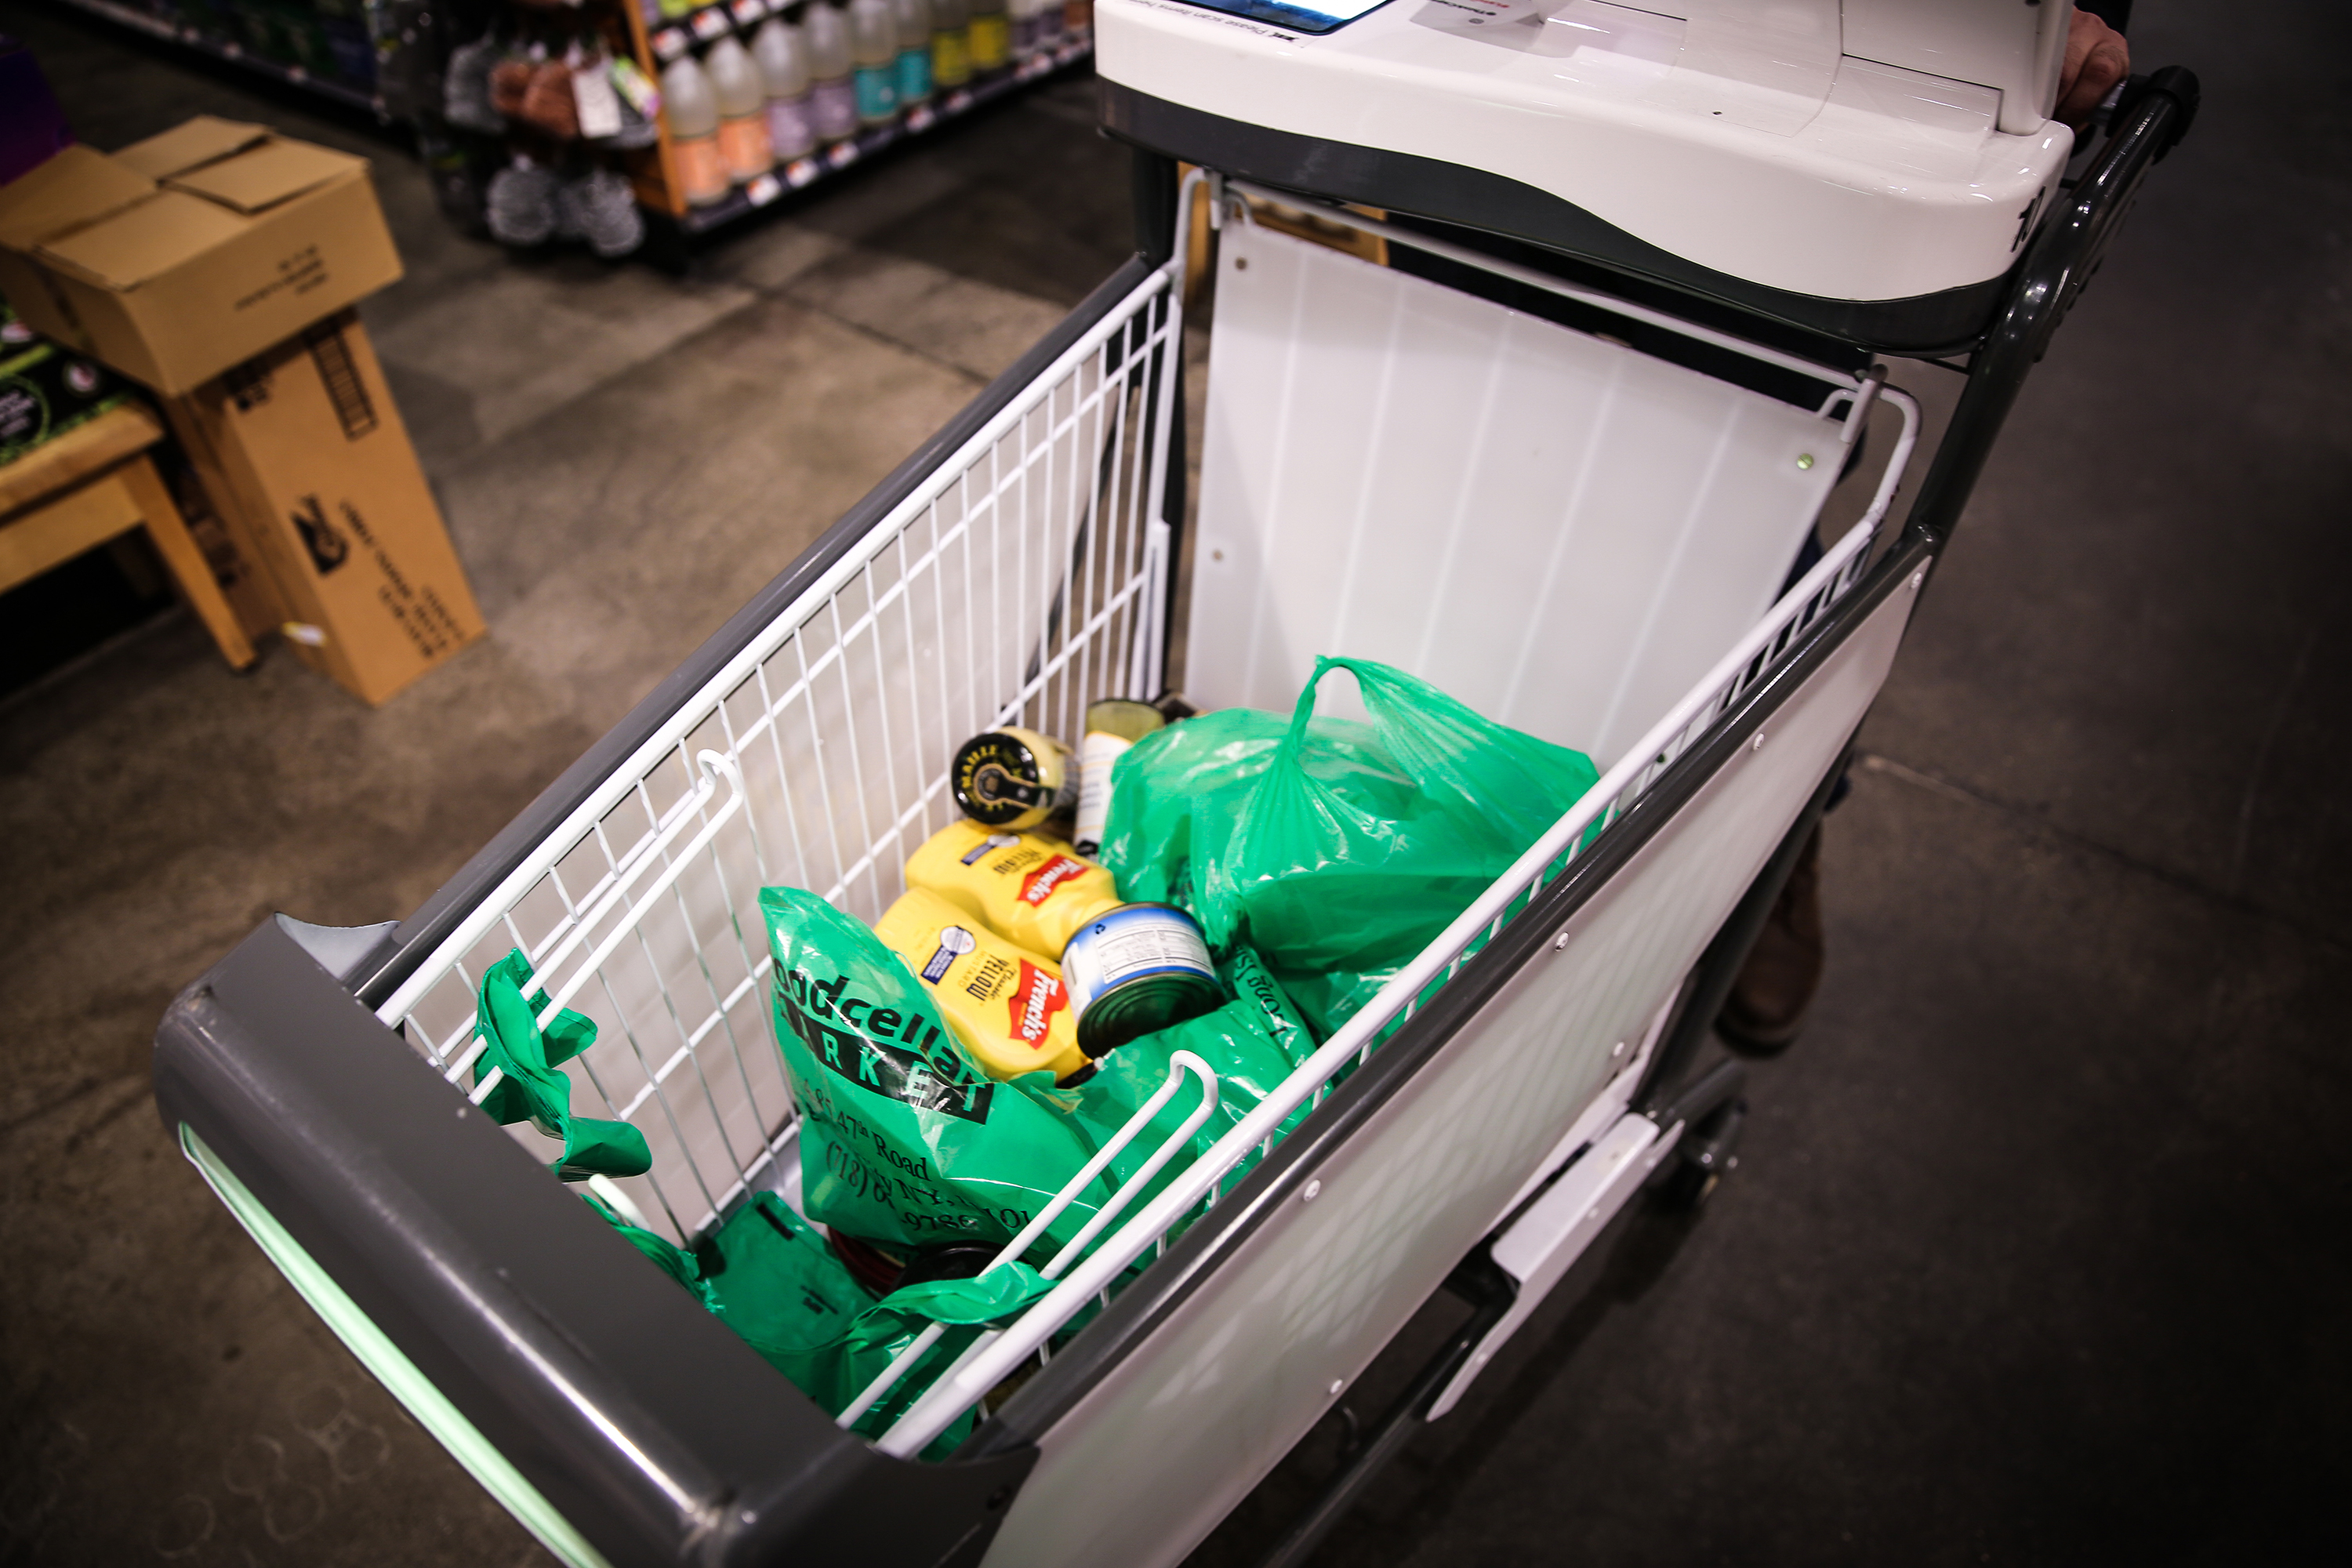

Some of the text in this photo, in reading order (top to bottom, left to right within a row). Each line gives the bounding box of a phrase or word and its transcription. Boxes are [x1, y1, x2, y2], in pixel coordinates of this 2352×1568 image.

[1158, 4, 1192, 15] items
[1193, 12, 1223, 22] scan
[1225, 20, 1269, 34] Please
[966, 954, 1010, 1002] YELLOW
[1022, 968, 1059, 1041] French's
[826, 1140, 869, 1198] (718)
[871, 1131, 932, 1182] Road
